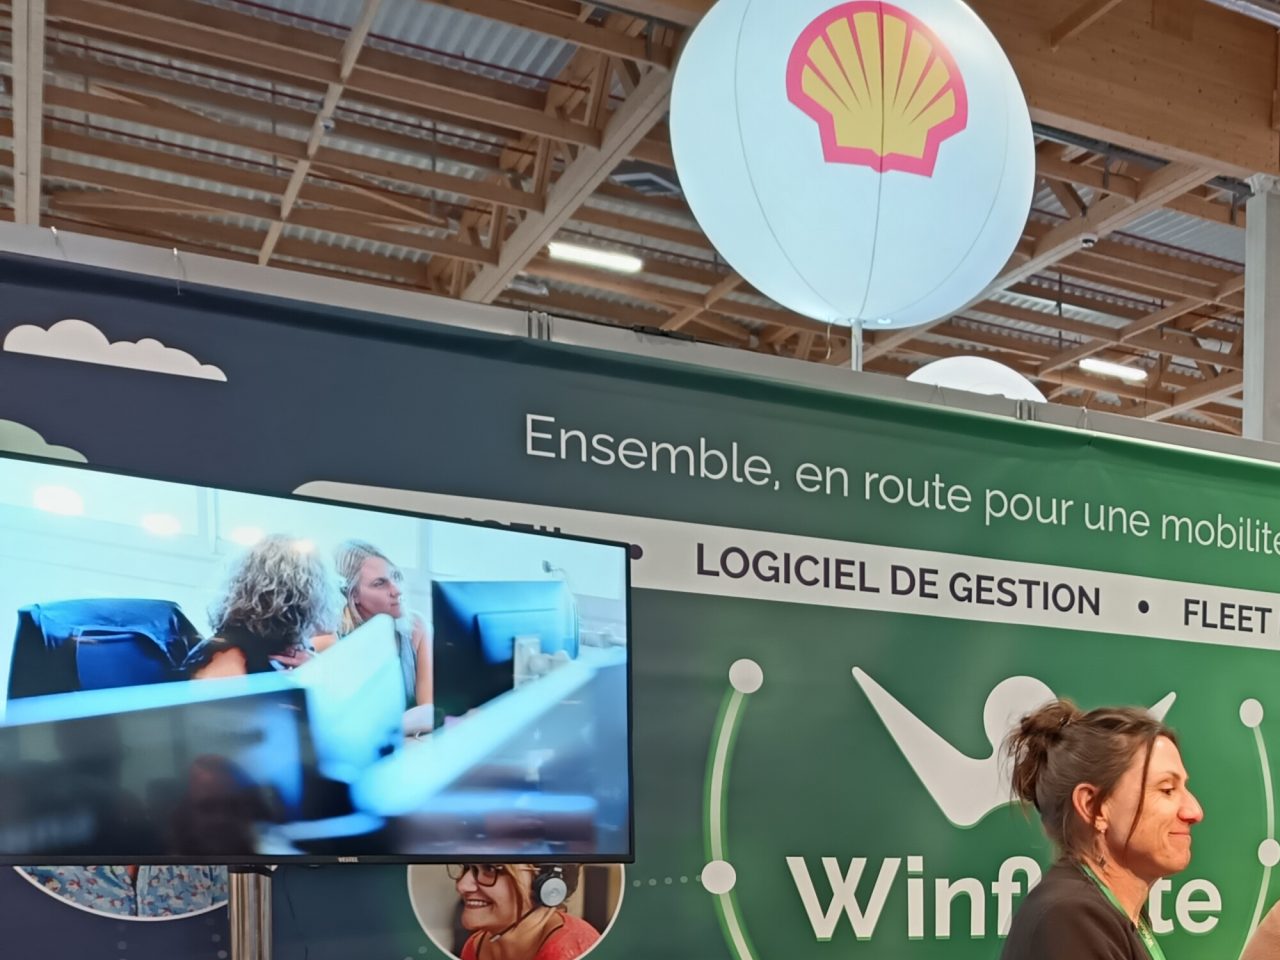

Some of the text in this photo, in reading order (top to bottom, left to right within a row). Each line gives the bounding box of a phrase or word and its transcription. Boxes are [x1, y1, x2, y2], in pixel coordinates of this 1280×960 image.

[526, 413, 779, 491] Ensemble,
[795, 462, 849, 497] en
[864, 473, 972, 513] route
[985, 488, 1074, 526] pour
[1084, 502, 1151, 537] une
[696, 542, 880, 594] LOGICIEL
[890, 564, 940, 600] DE
[949, 571, 1101, 617] GESTION
[1183, 598, 1273, 634] FLEET
[785, 855, 1223, 941] Winfte
